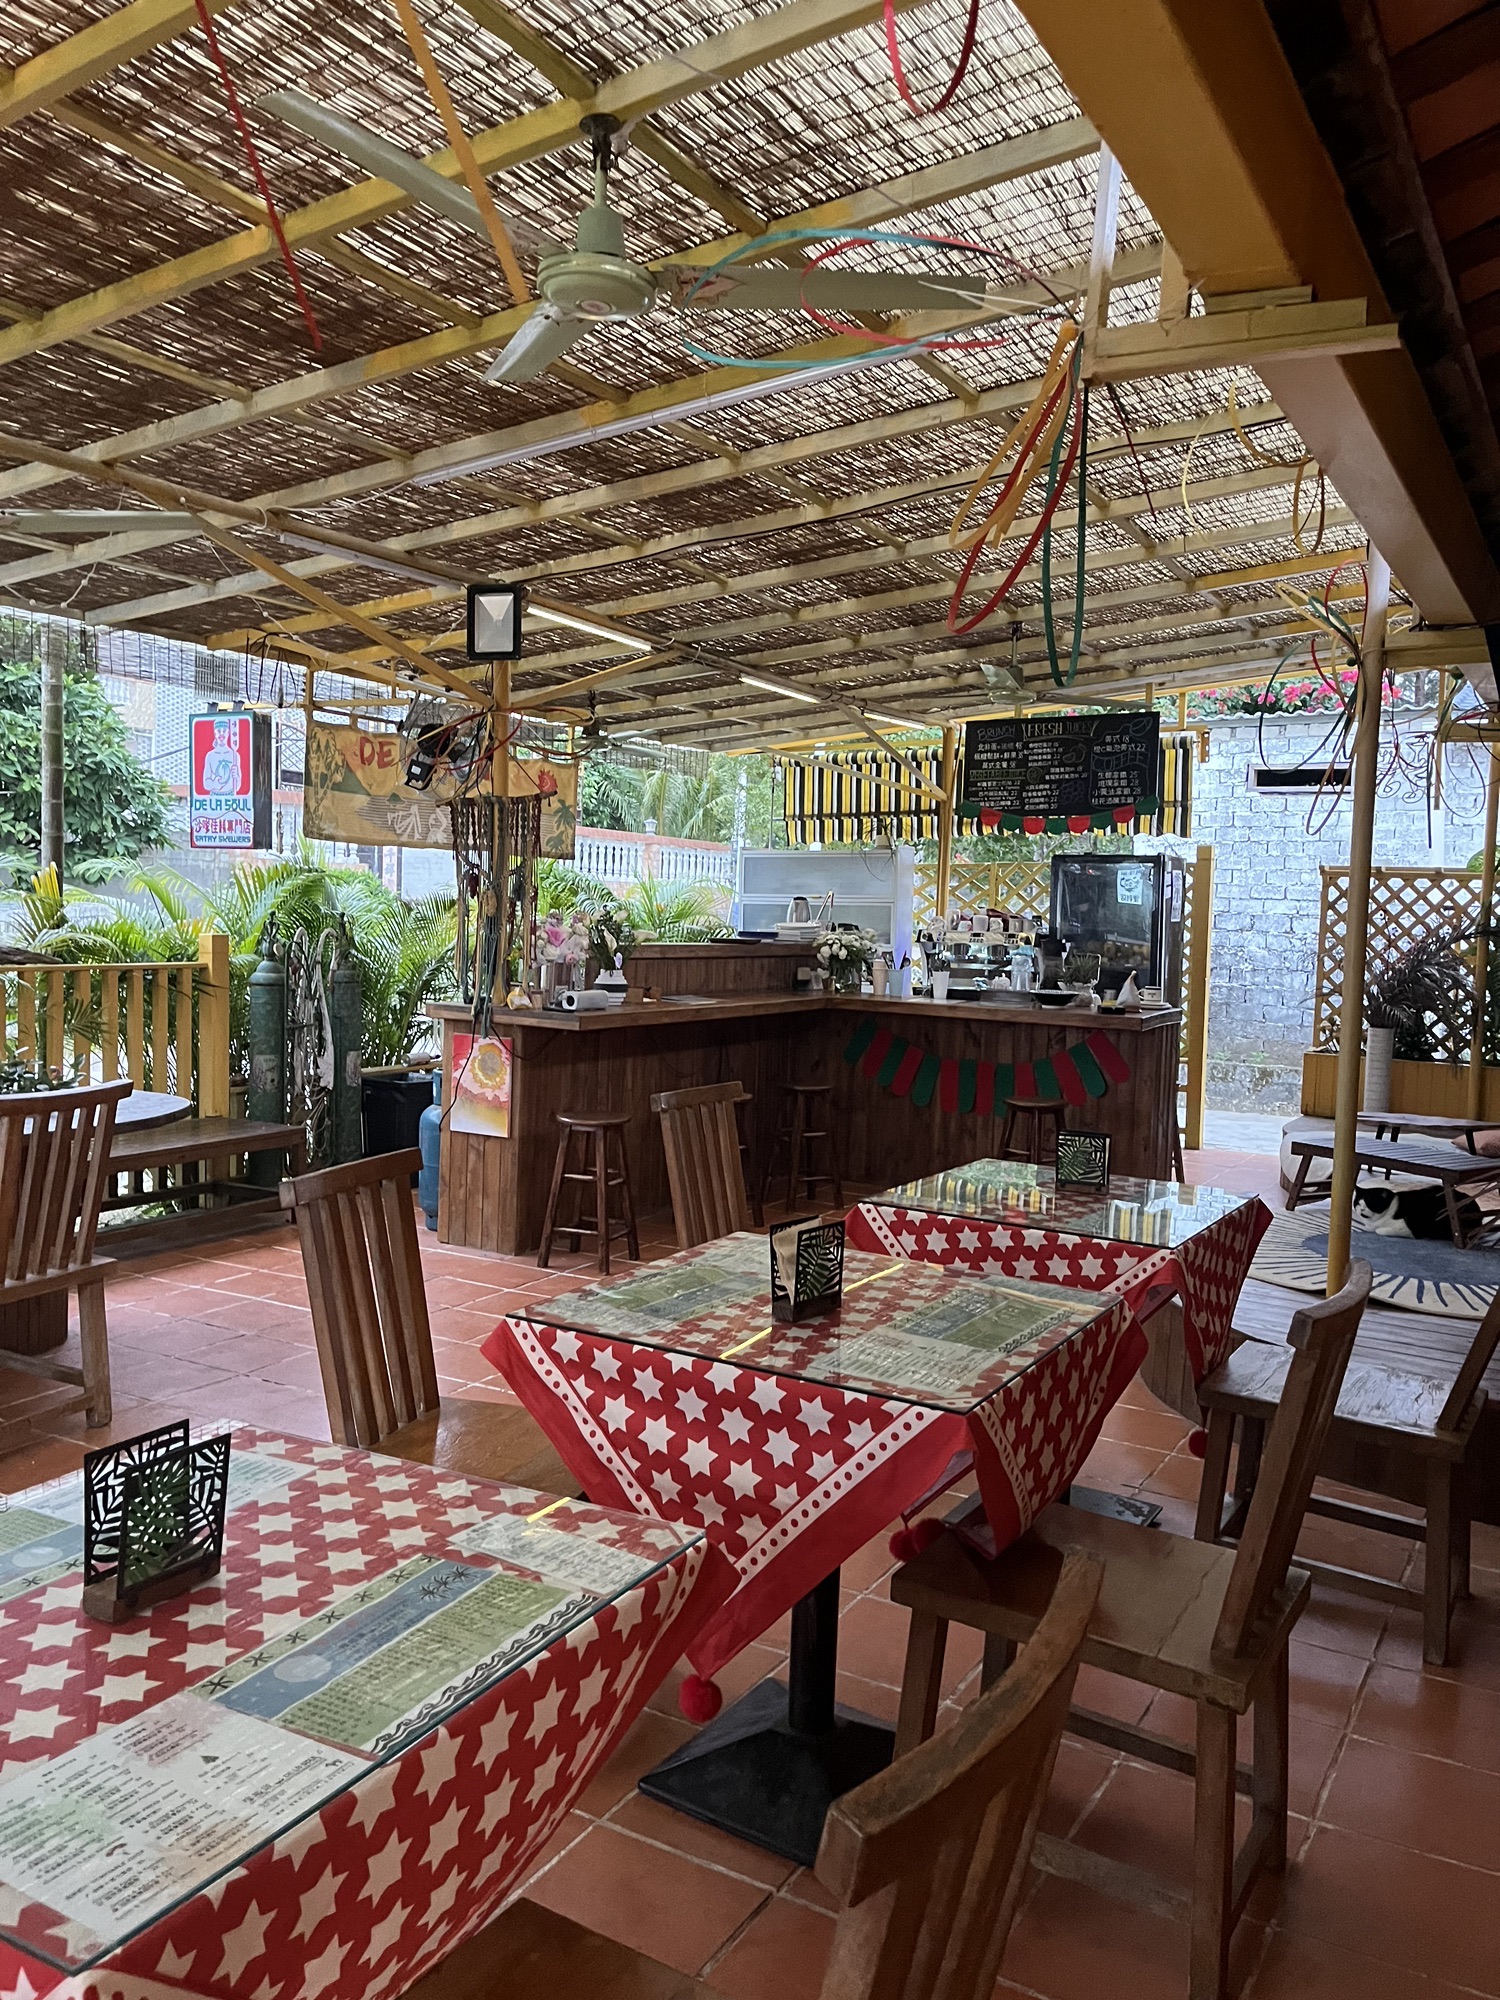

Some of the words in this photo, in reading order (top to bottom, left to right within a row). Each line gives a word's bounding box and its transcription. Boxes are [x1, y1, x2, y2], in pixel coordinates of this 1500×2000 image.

[977, 725, 1015, 740] BRUNCH
[1028, 722, 1063, 737] FRESH
[360, 736, 397, 769] DE
[1136, 743, 1146, 751] 22
[194, 798, 208, 811] DE
[209, 798, 222, 811] LA
[218, 835, 252, 843] SKEWERS
